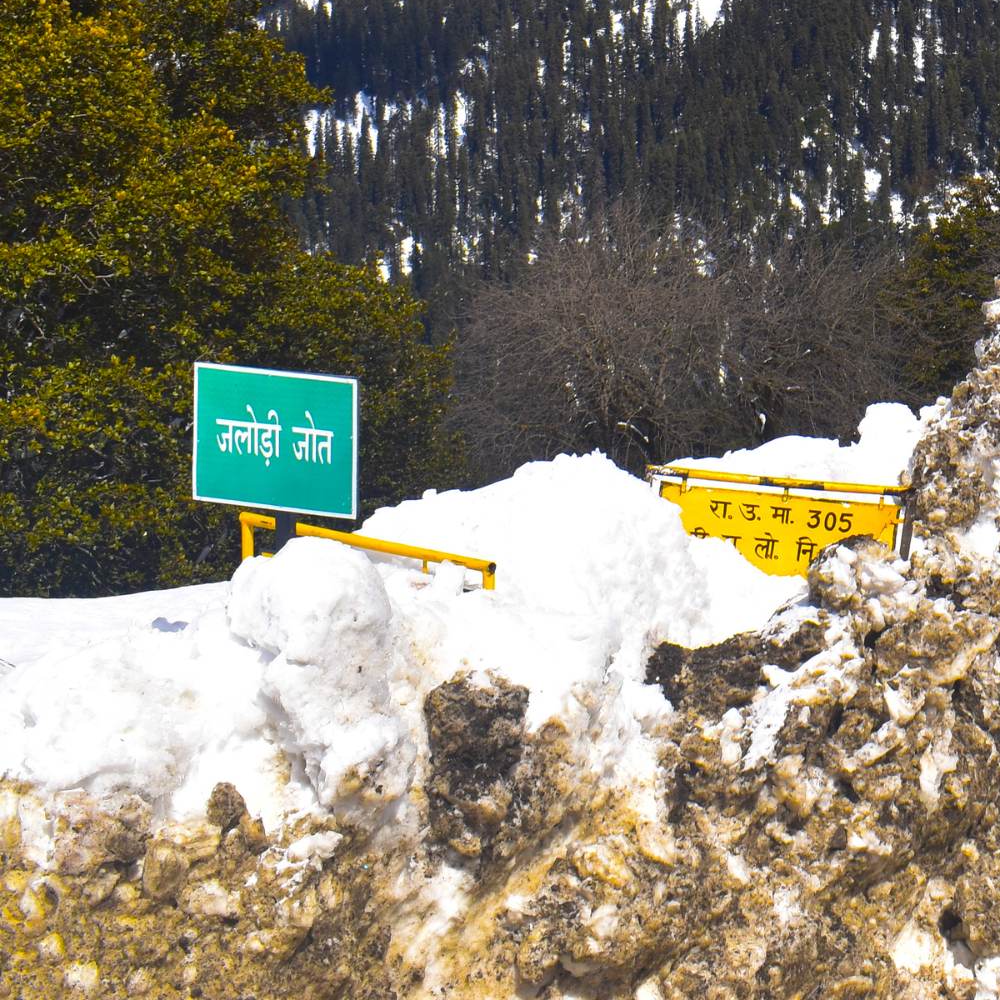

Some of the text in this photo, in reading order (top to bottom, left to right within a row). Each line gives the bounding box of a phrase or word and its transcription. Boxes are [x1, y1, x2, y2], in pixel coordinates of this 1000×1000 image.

[216, 404, 334, 467] जलोड़ी जोत
[771, 506, 794, 524] मा.
[807, 509, 853, 533] 305
